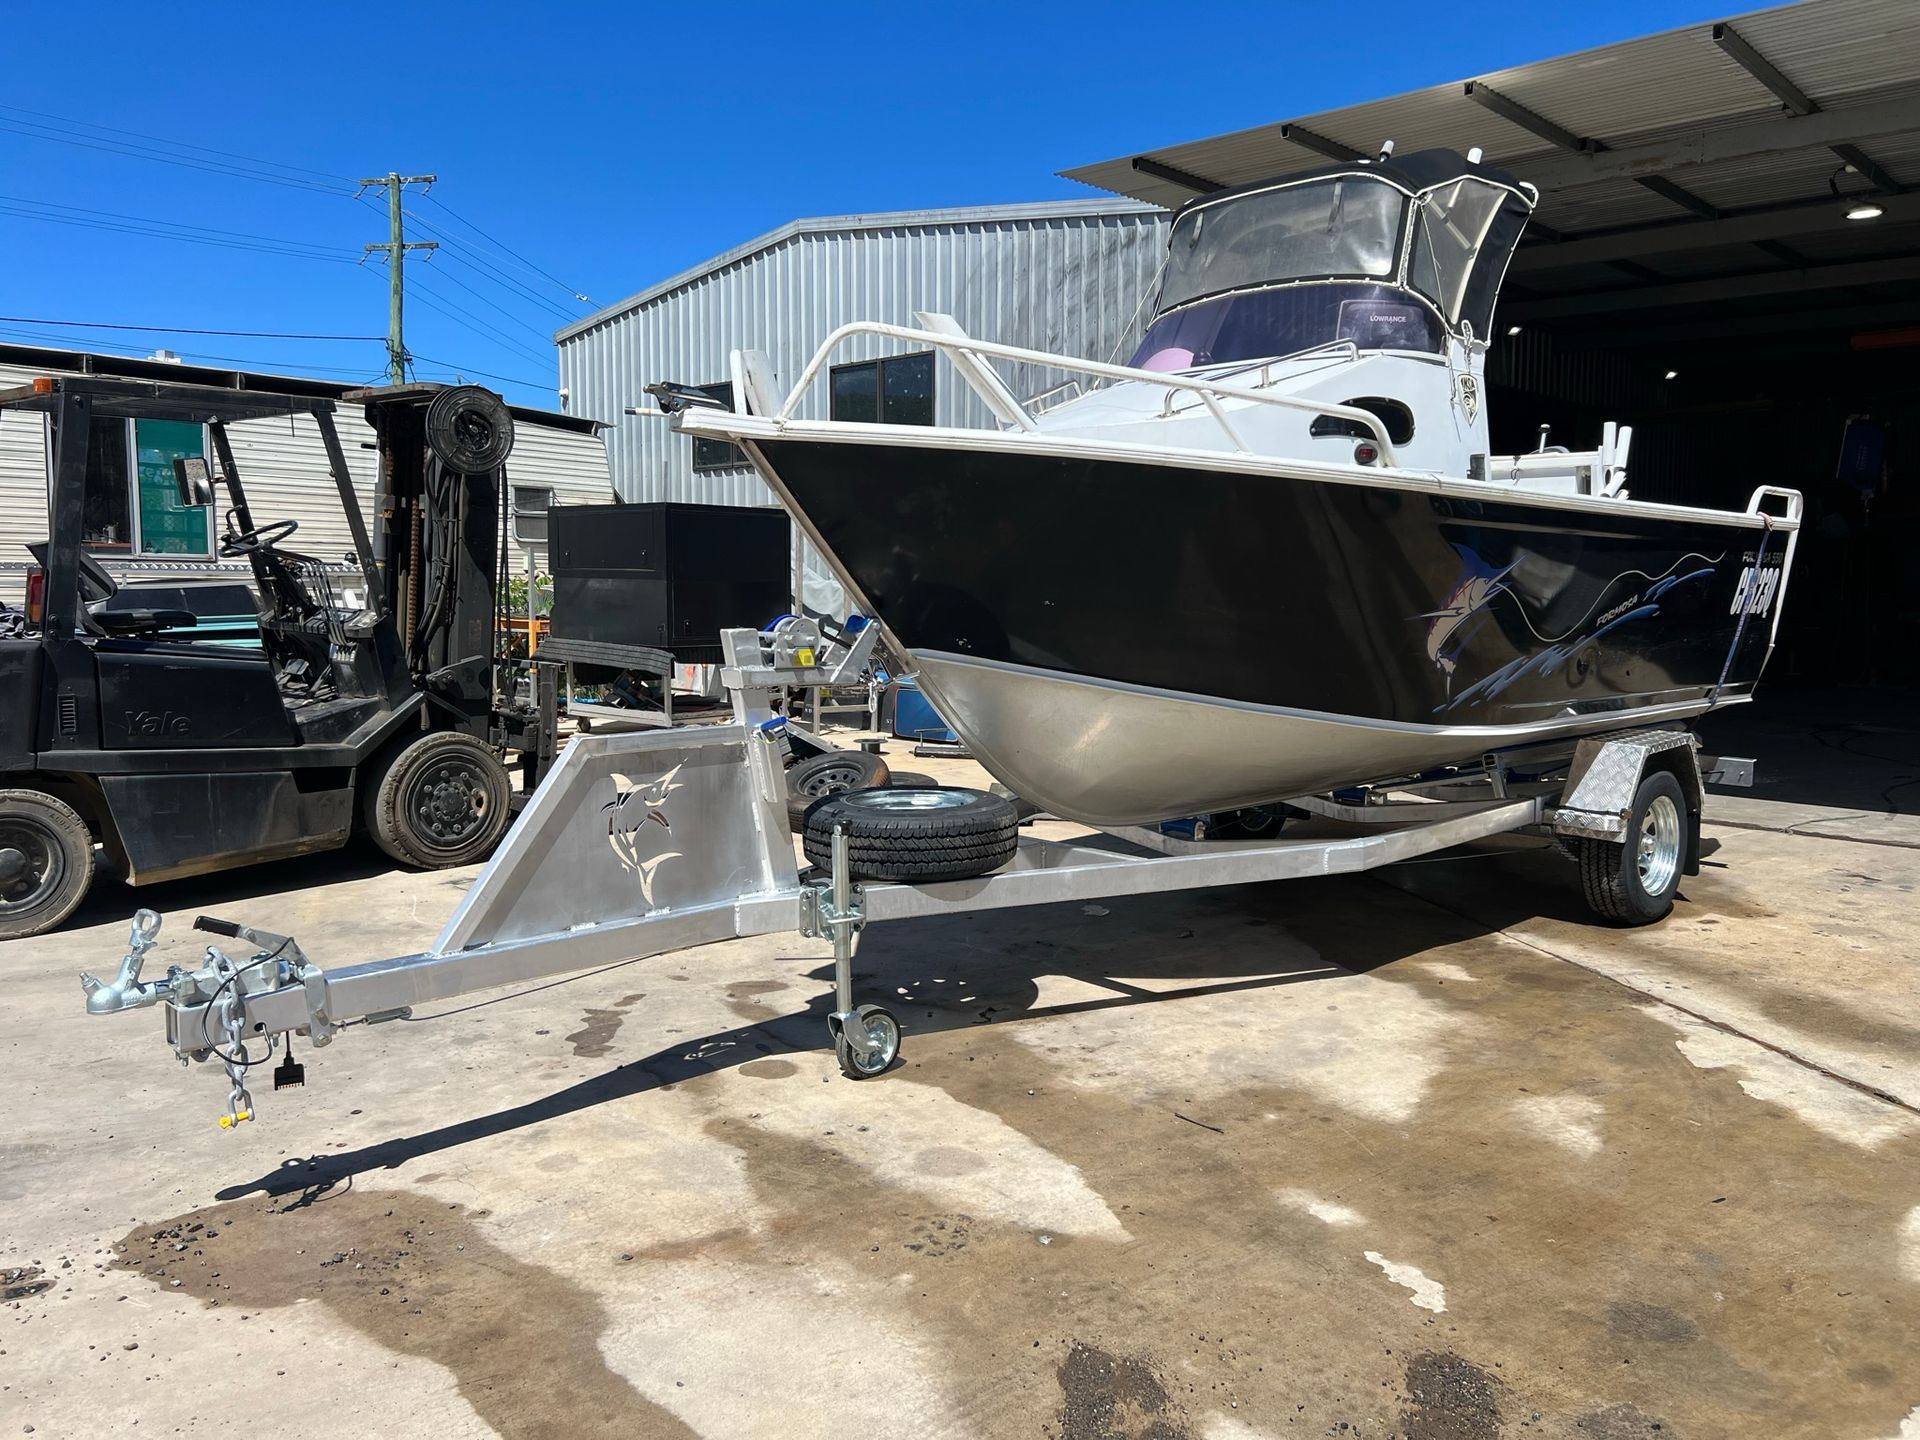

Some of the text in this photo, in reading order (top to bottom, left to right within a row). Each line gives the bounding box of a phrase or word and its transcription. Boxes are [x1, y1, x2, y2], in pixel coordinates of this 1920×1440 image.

[1370, 315, 1407, 323] LOWRANCE
[1595, 594, 1638, 627] FORMOSA
[123, 710, 192, 735] Yale
